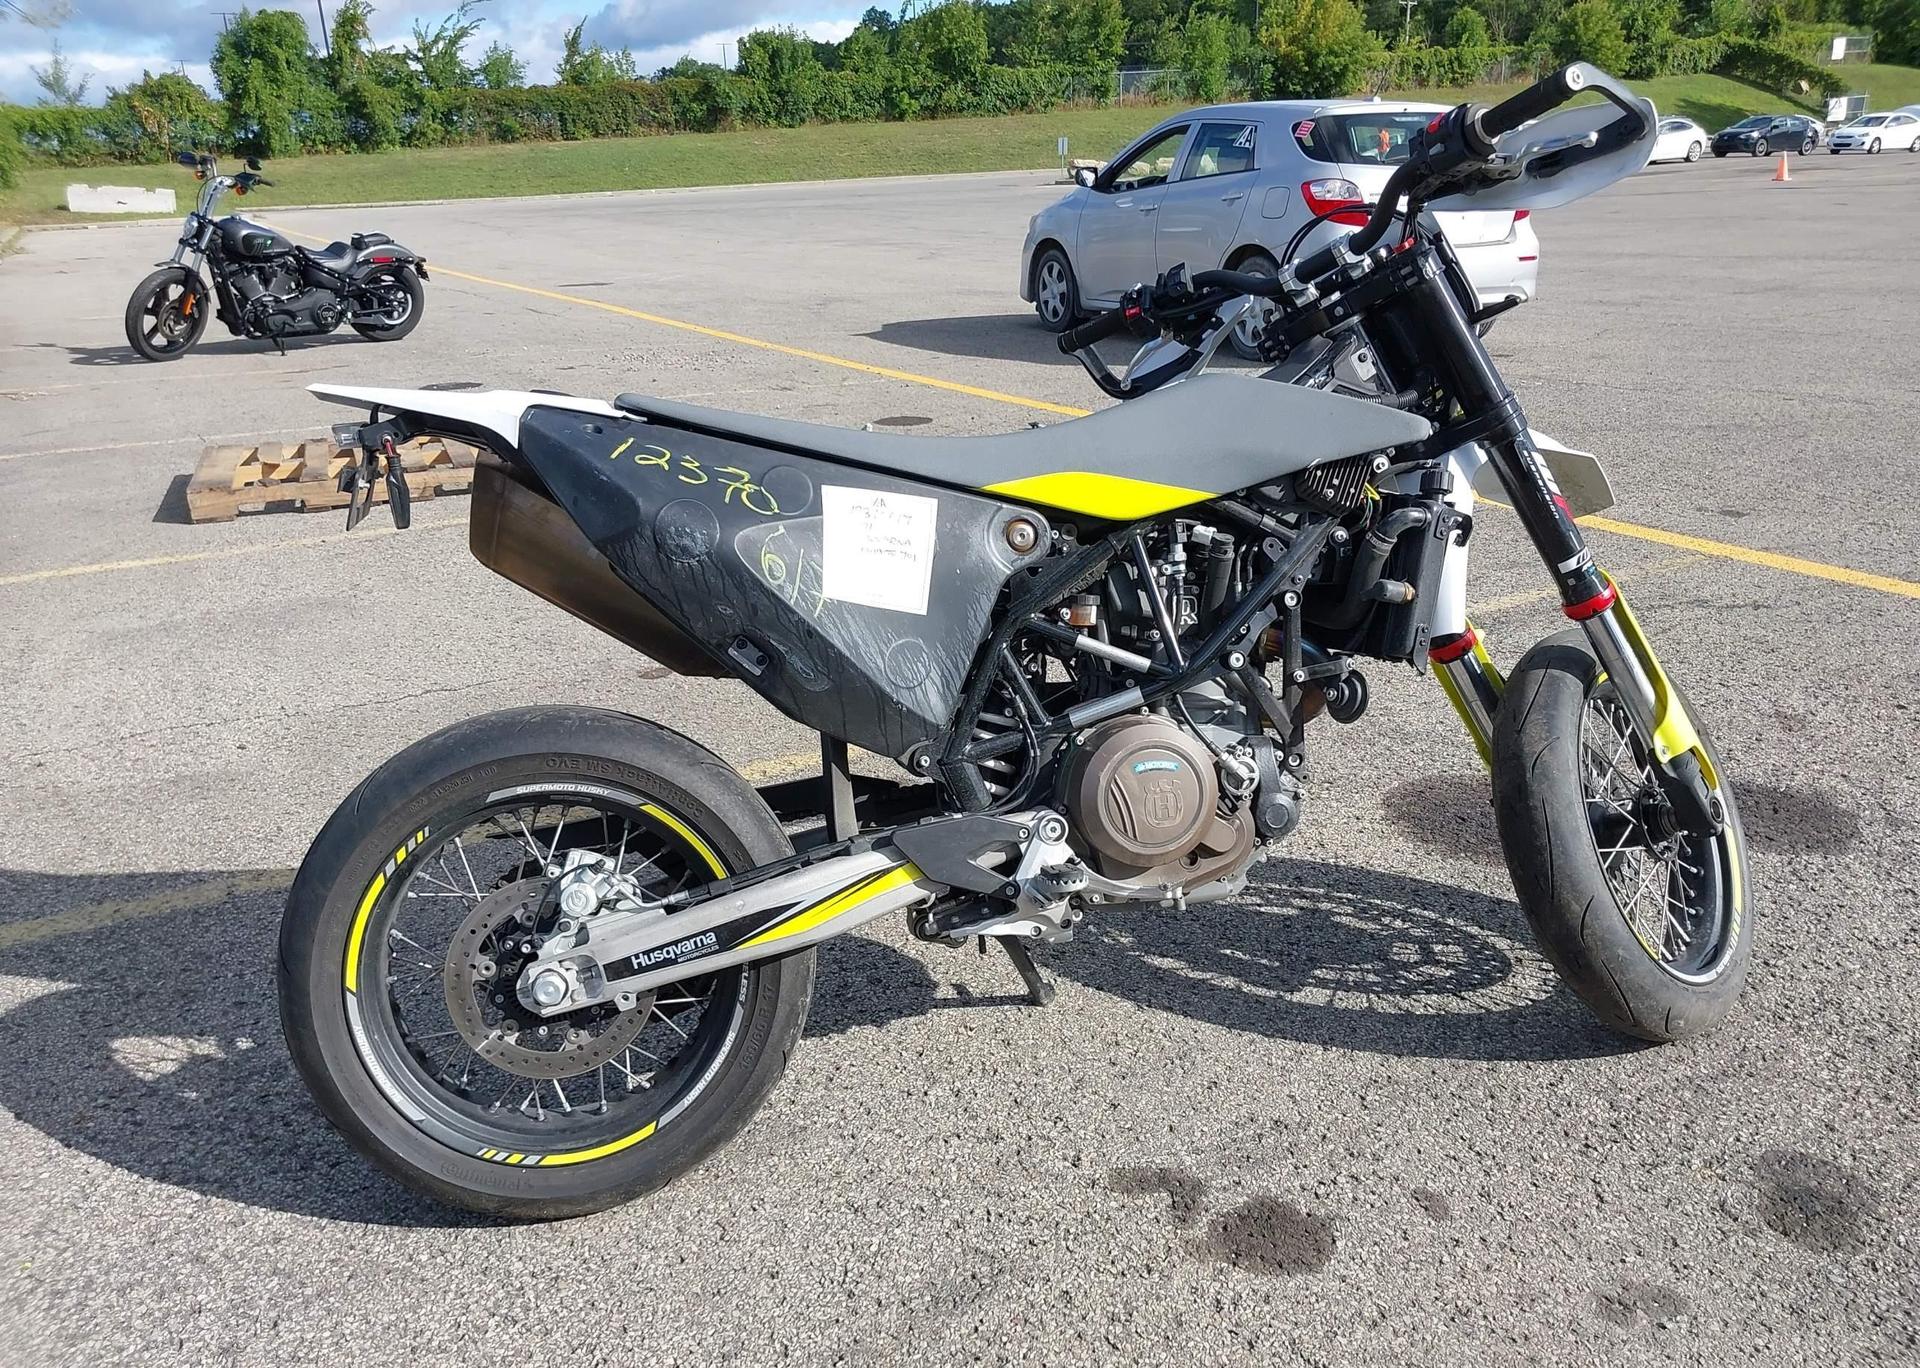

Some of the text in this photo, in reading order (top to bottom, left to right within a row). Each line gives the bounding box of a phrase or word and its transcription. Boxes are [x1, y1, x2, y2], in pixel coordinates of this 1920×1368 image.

[610, 437, 778, 515] 12370
[545, 757, 583, 770] EVO
[516, 783, 611, 796] SUPERMOTO HUSKY
[630, 931, 718, 970] Husqvarna
[677, 944, 720, 963] MOTORCYCLES
